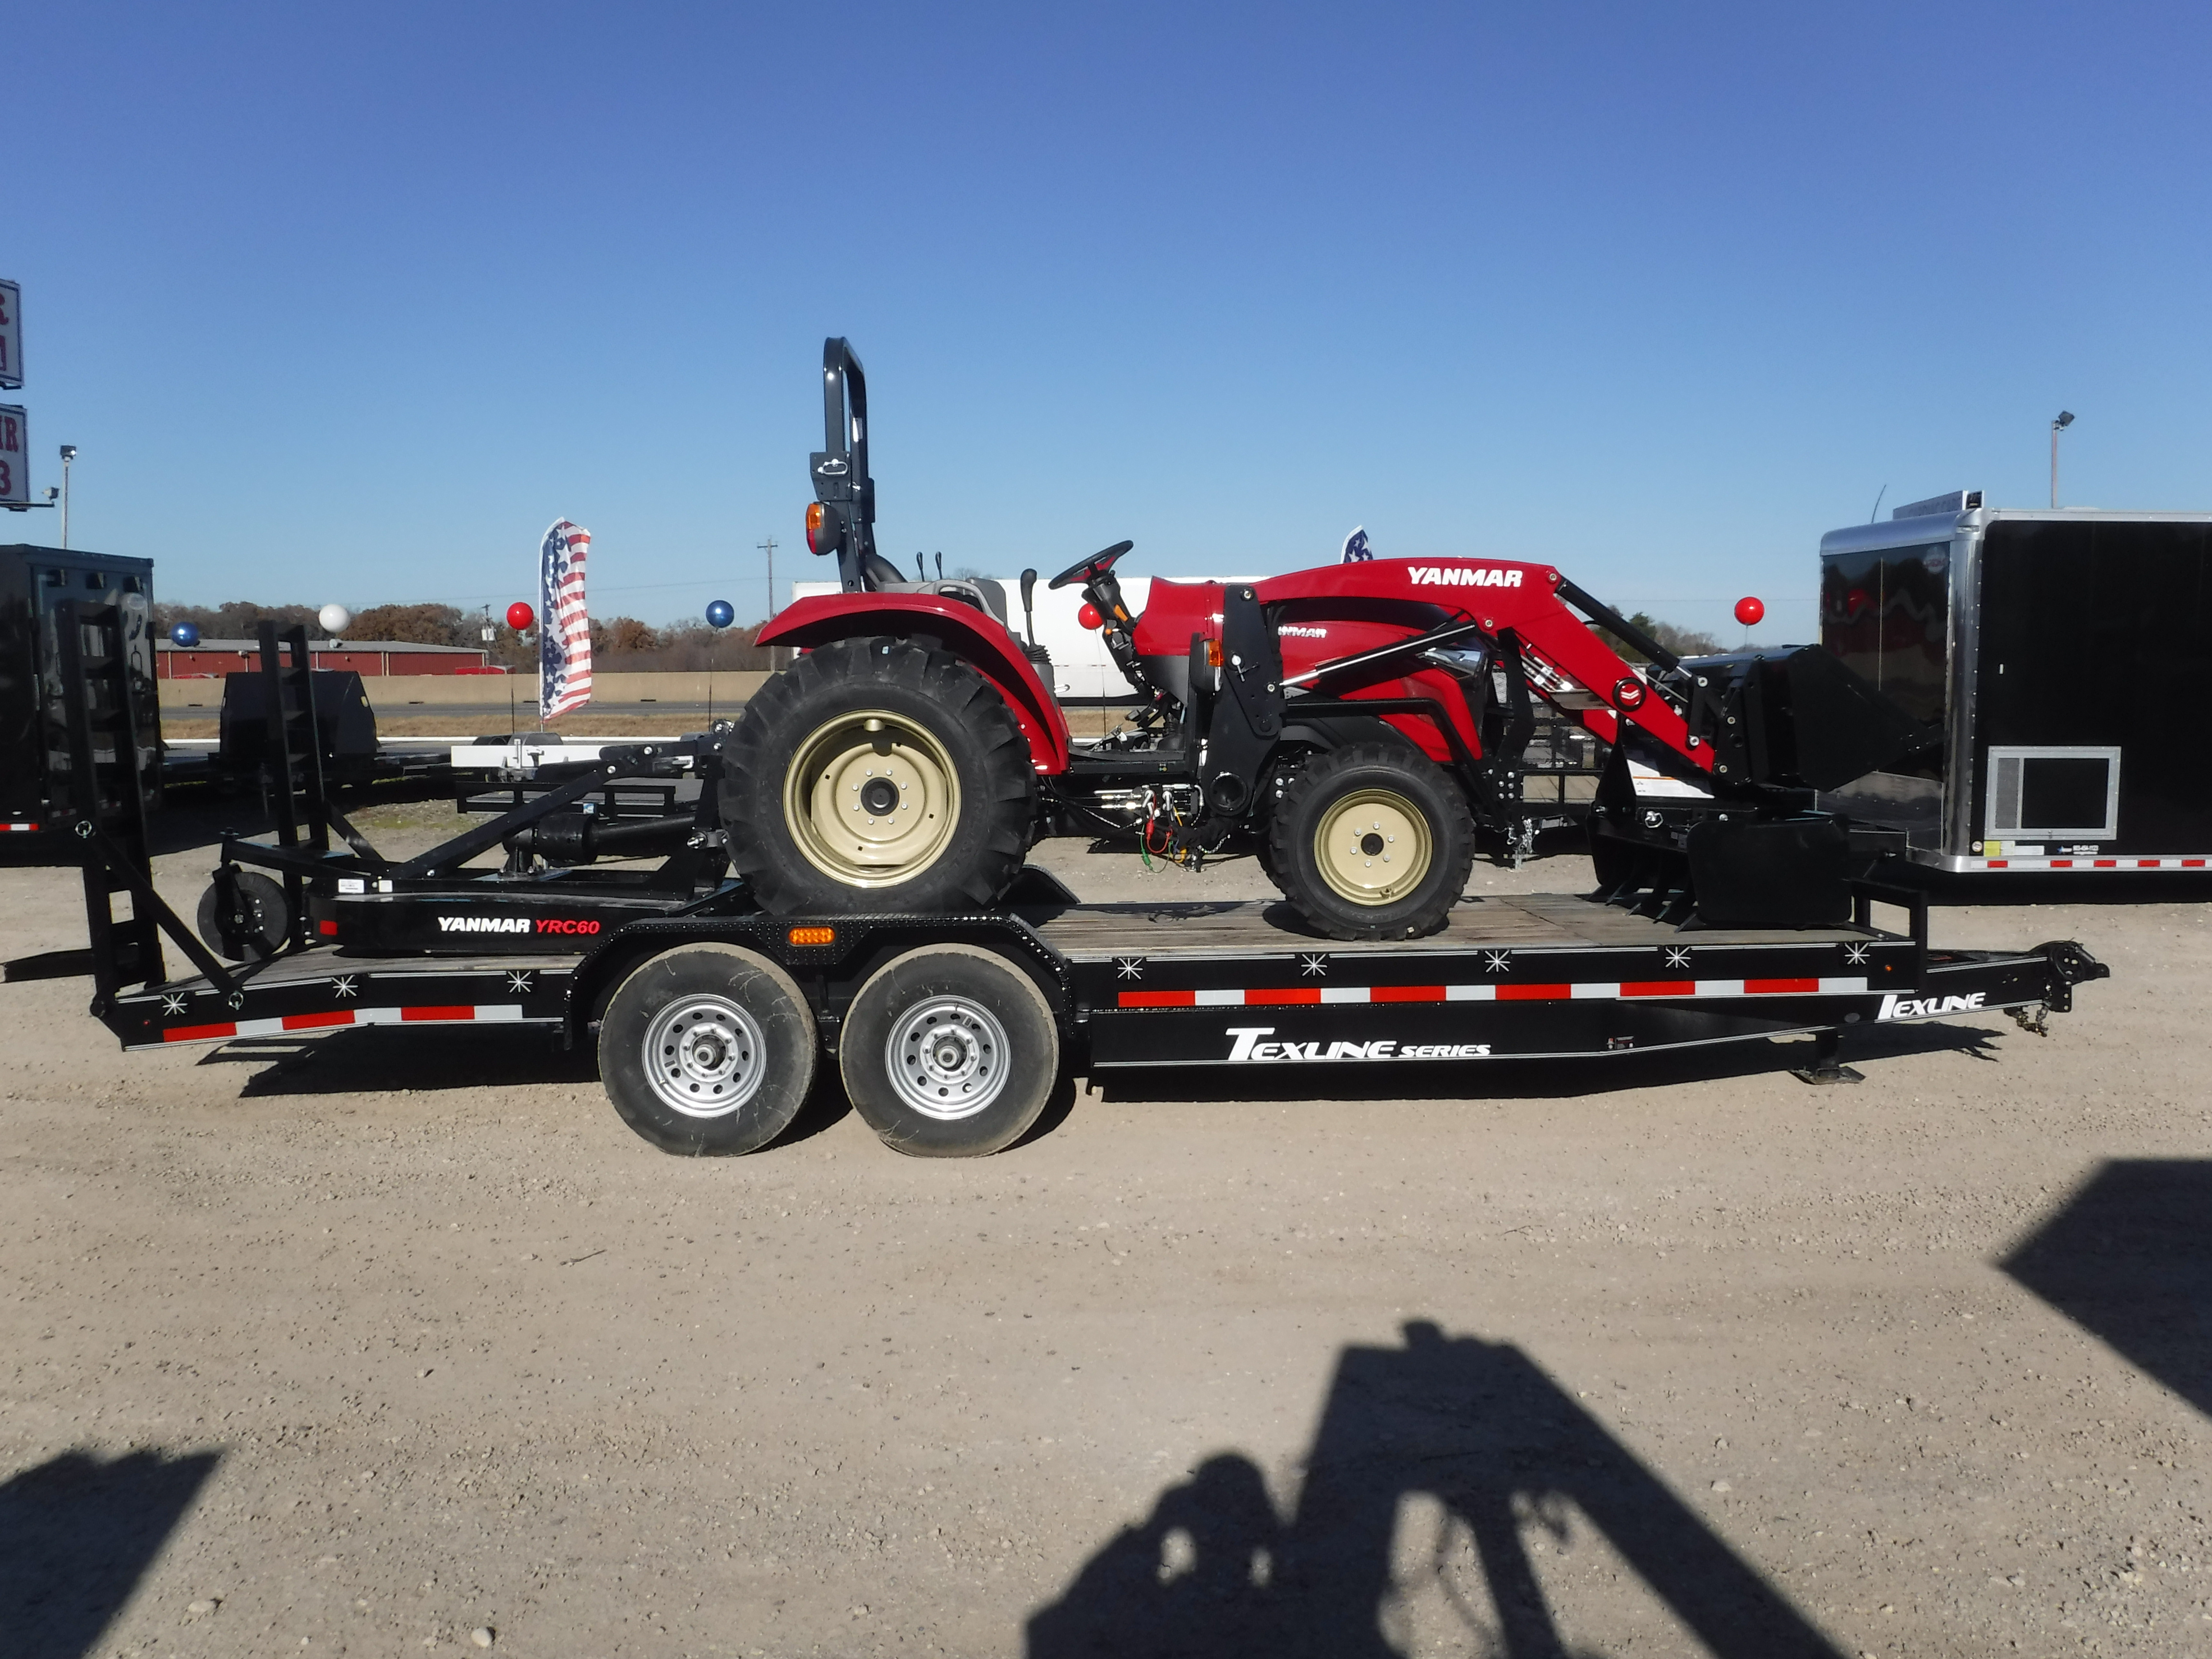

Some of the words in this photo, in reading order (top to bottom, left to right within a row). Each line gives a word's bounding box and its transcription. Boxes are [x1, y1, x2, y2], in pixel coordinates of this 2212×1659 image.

[1407, 566, 1523, 587] YANMAR
[1278, 626, 1327, 638] NMAR
[438, 917, 530, 933] YANMAR
[536, 919, 600, 934] YRC60
[1226, 1027, 1397, 1060] TEXLINE
[1398, 1045, 1491, 1058] SERIES
